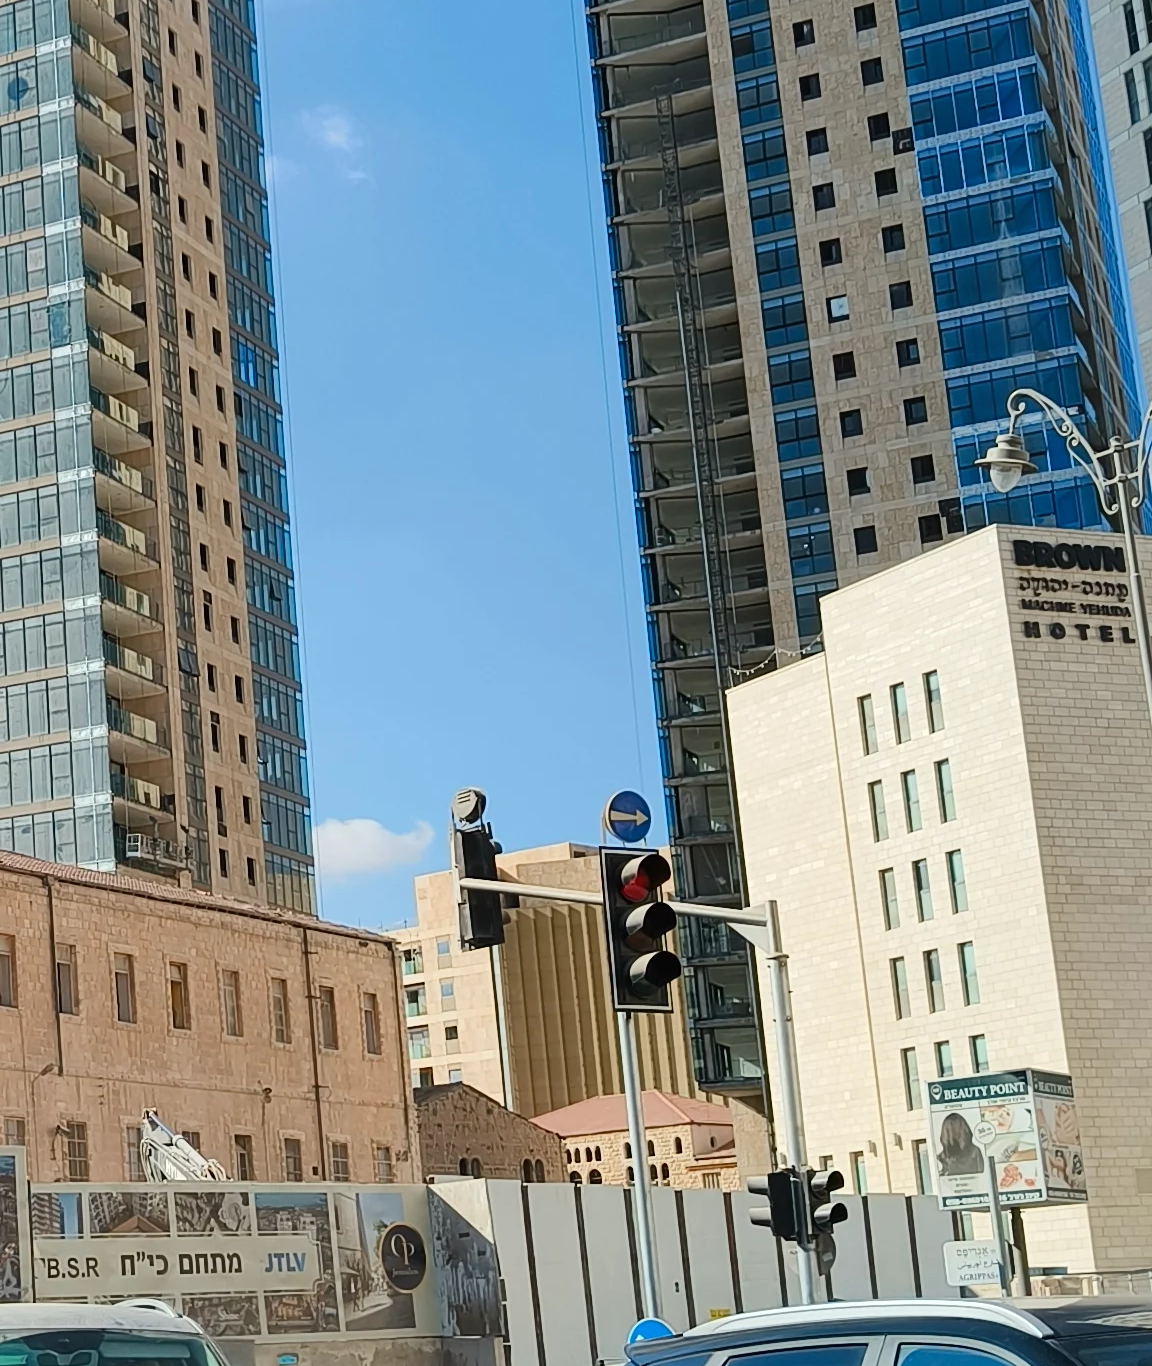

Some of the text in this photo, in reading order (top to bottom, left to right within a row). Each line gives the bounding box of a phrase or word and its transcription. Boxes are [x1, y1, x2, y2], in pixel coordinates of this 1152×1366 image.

[1013, 540, 1126, 573] BROWN
[1079, 602, 1132, 617] YEHUDA
[1023, 620, 1136, 644] HOTEL
[944, 1086, 988, 1101] BEAUTY
[990, 1081, 1026, 1096] POINT
[179, 1252, 243, 1275] מתחם
[265, 1251, 307, 1273] JTLV
[958, 1272, 996, 1282] AGRIPPAS
